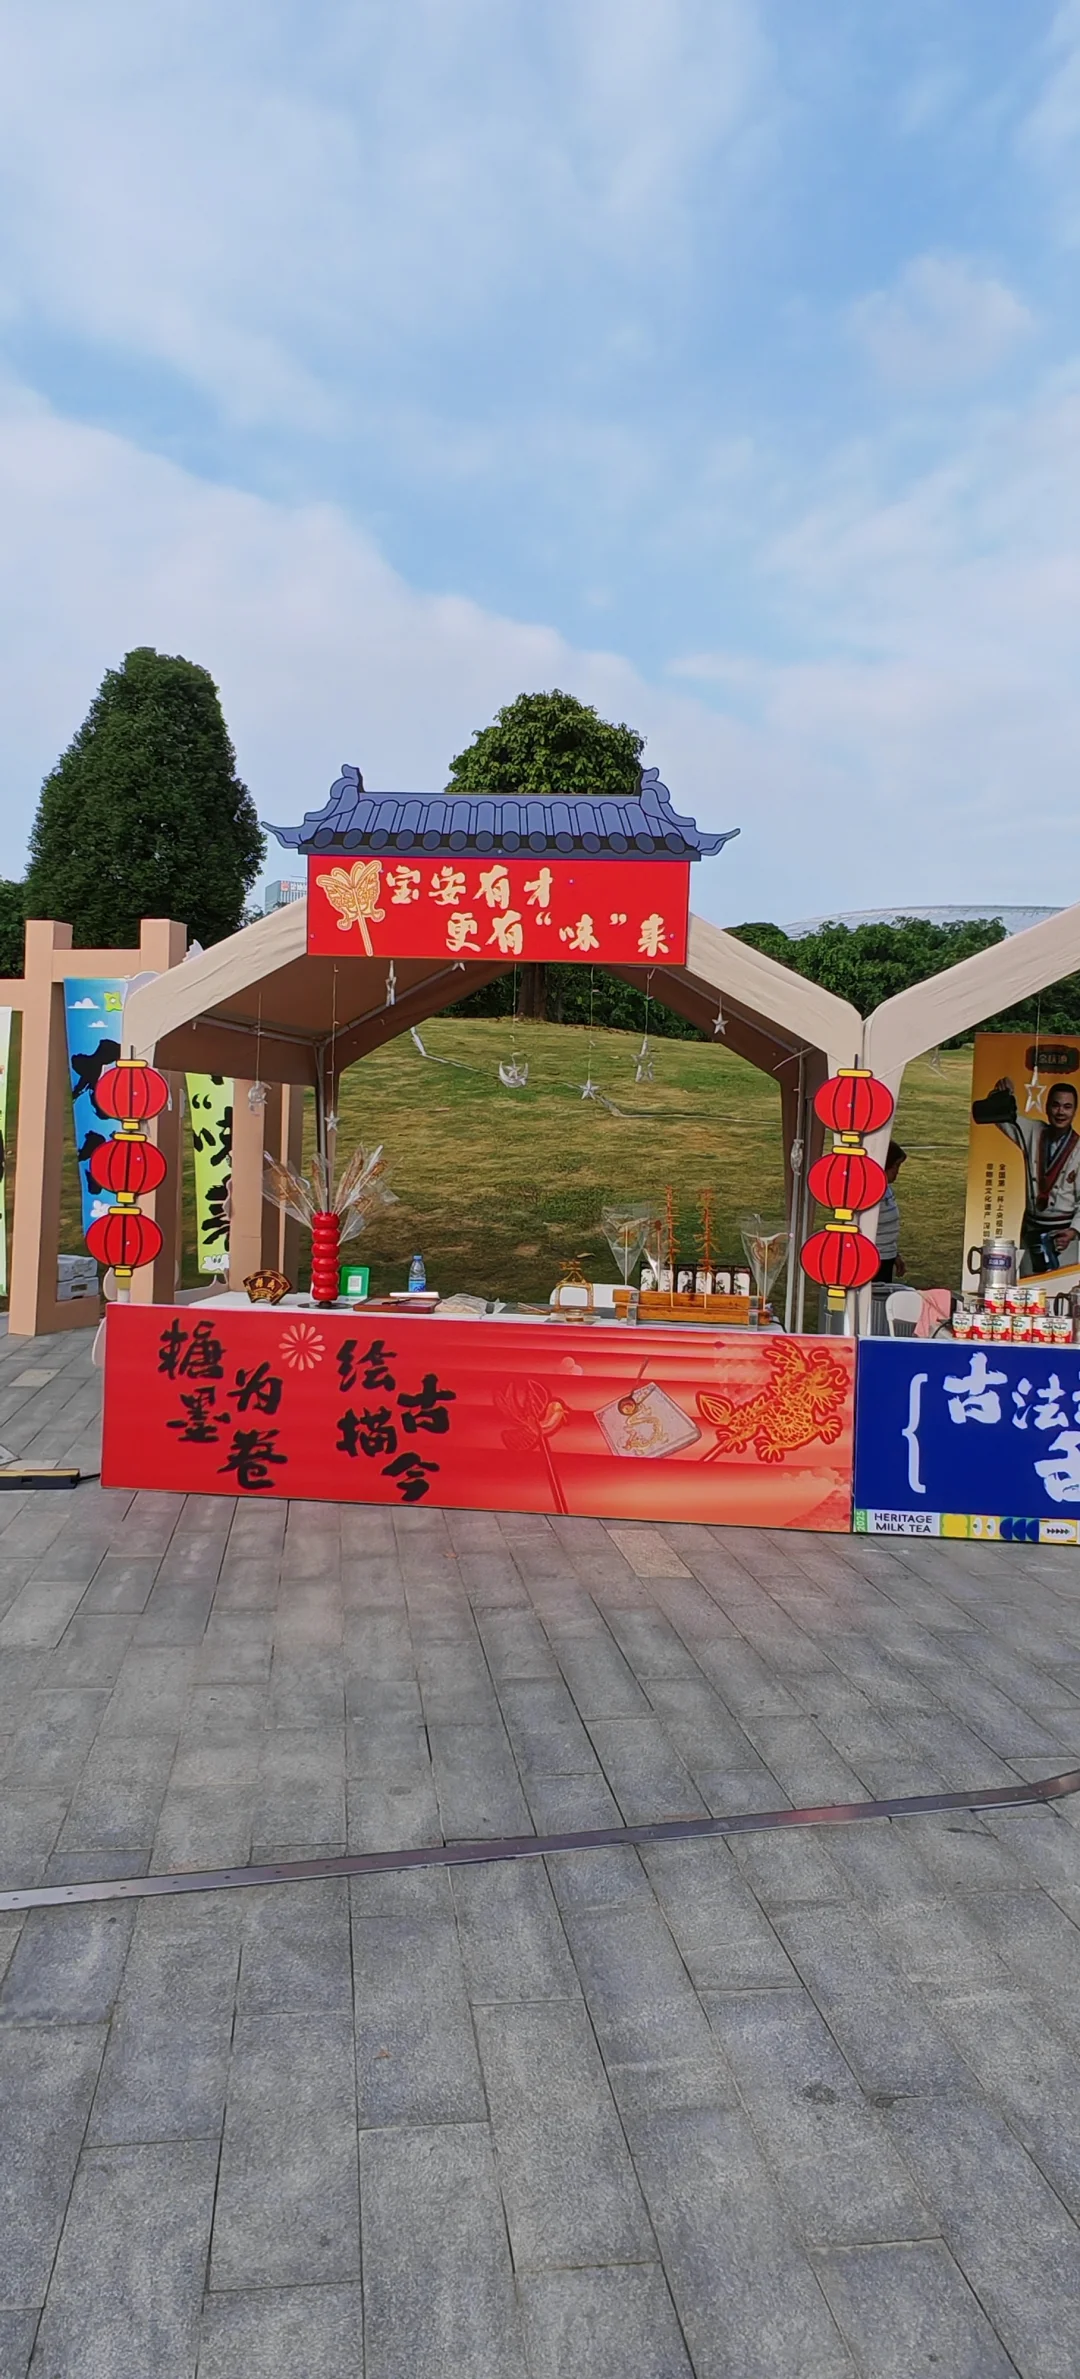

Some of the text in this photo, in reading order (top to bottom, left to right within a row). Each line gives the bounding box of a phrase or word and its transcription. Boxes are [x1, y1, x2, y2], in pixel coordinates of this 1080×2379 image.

[995, 1163, 1006, 1239] 全国第一杯上央视的
[943, 1352, 1080, 1430] 古法
[856, 1510, 865, 1532] 2025
[874, 1512, 933, 1524] HERITAGE
[876, 1523, 931, 1533] MILK TEA
